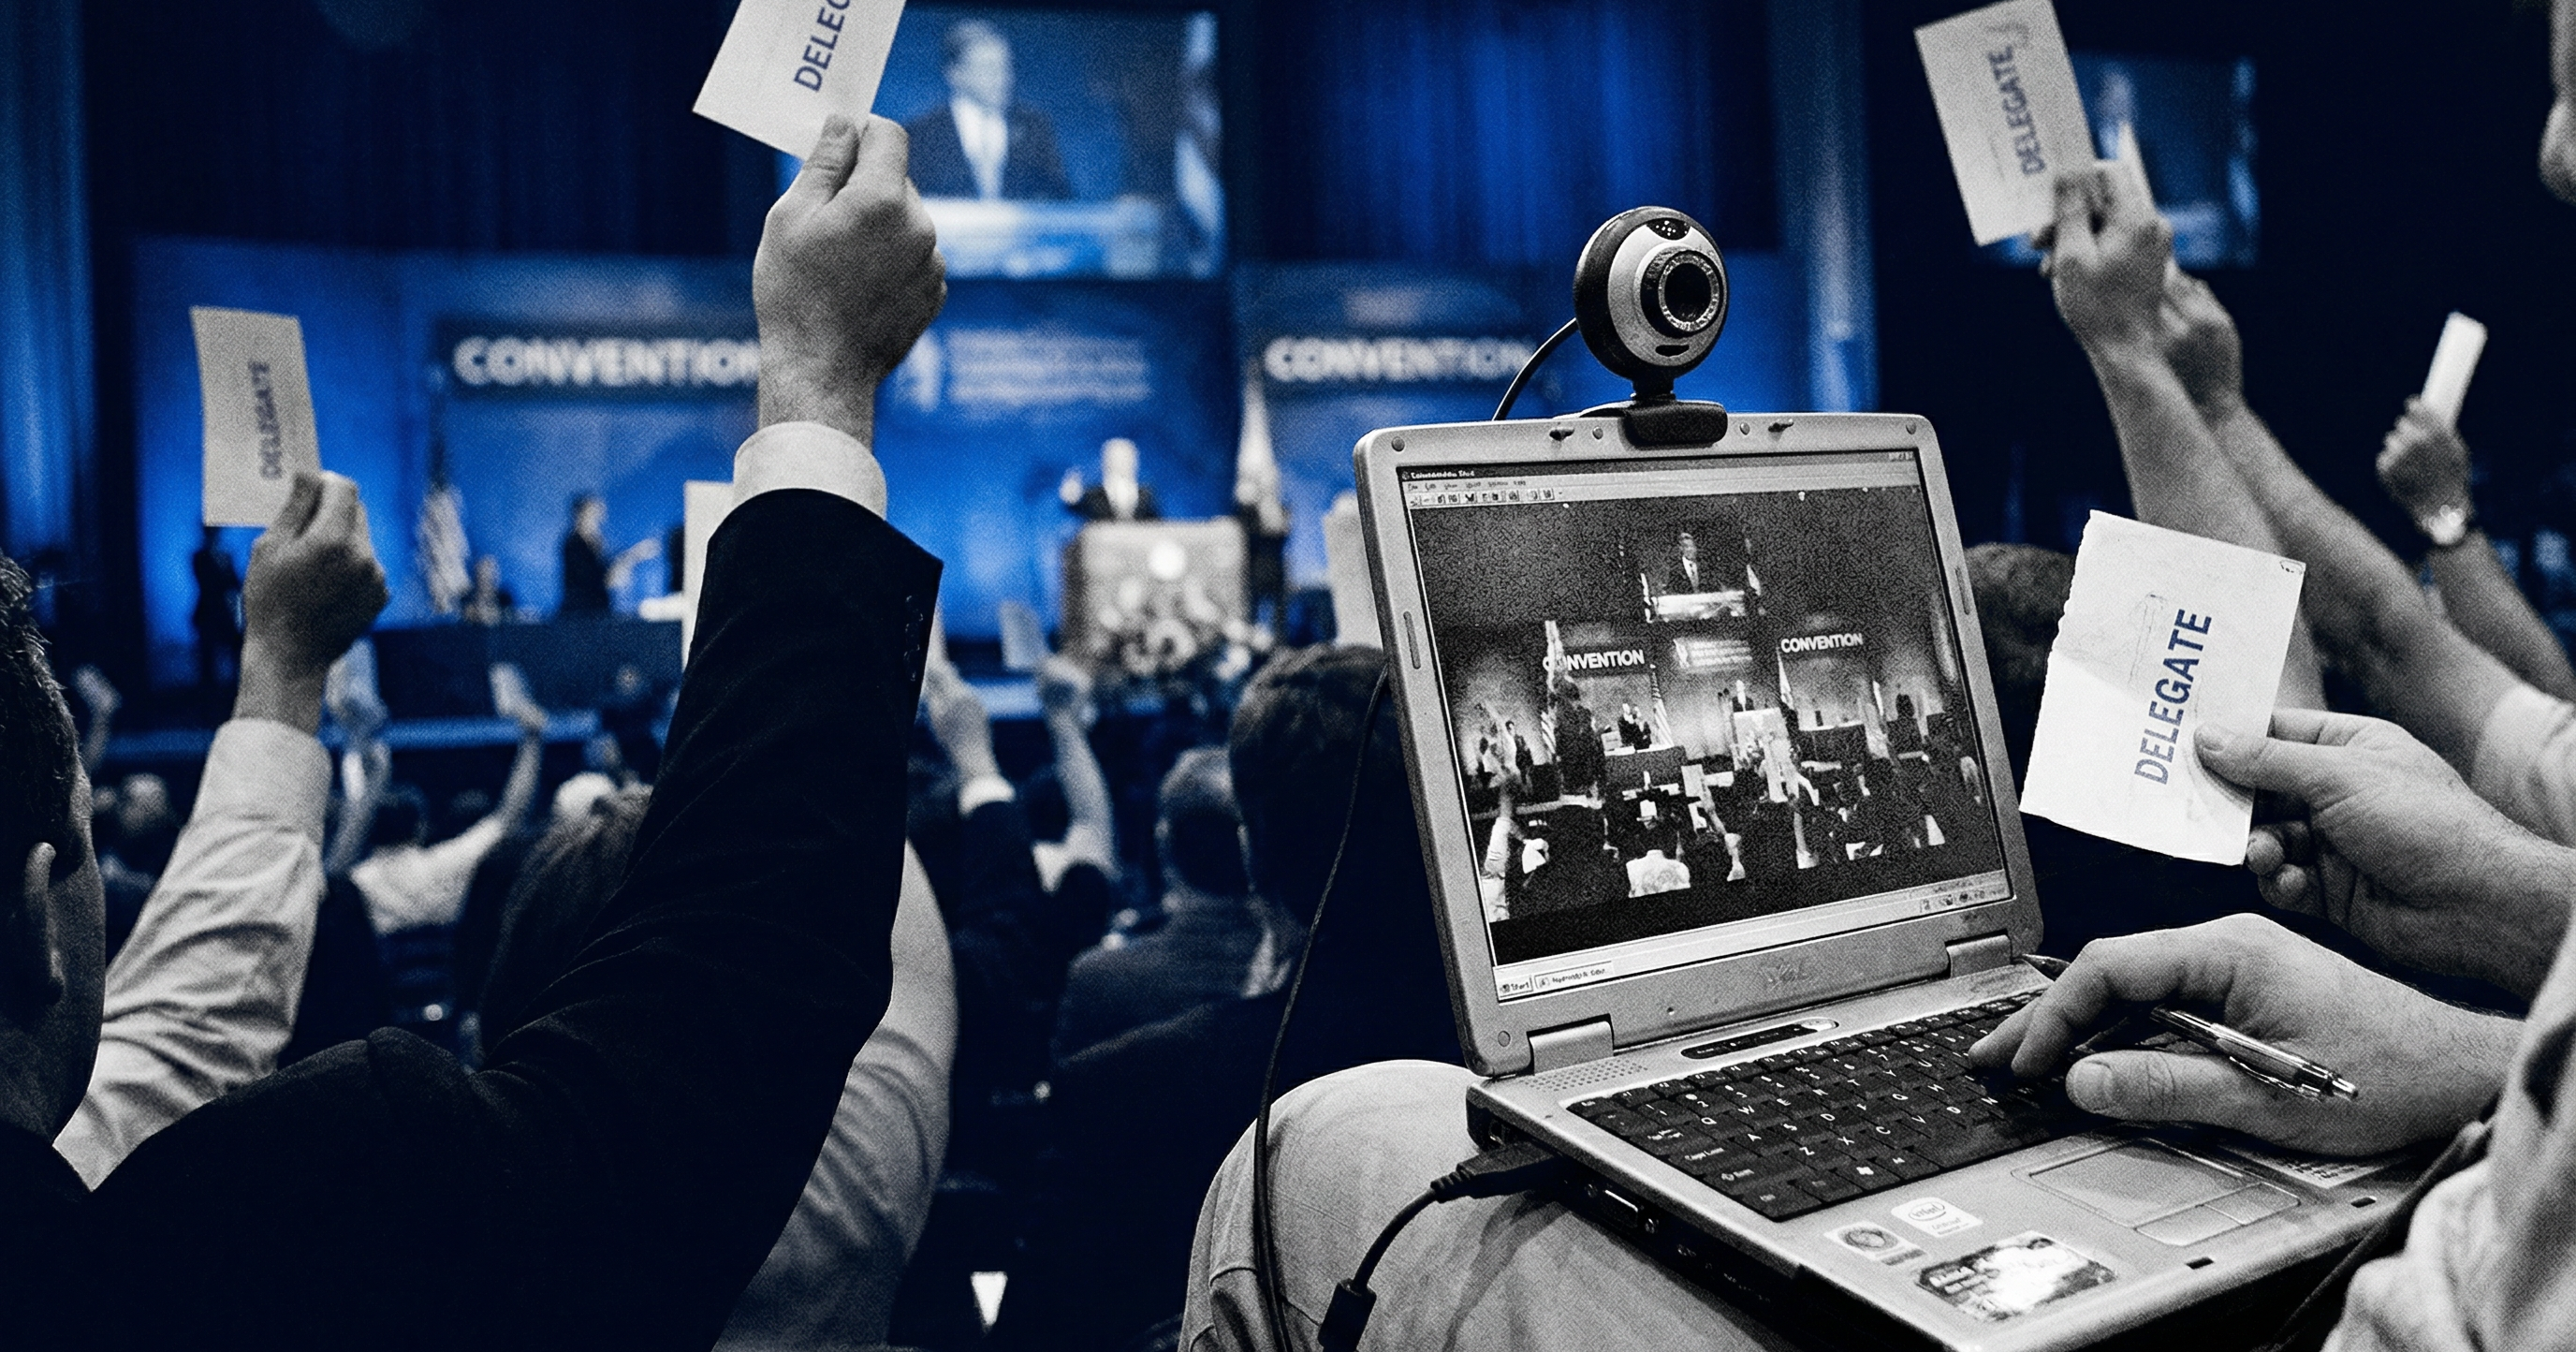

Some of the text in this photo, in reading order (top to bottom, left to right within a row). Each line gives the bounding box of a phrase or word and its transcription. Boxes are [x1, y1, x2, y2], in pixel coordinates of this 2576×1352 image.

[1987, 46, 2047, 176] DELEGATE
[1264, 336, 1536, 381] CONVENTION
[247, 360, 283, 480] DELEGATE
[1542, 649, 1646, 671] CNVENTION
[1780, 632, 1864, 654] CONVENTION
[2133, 609, 2212, 785] DELEGATE
